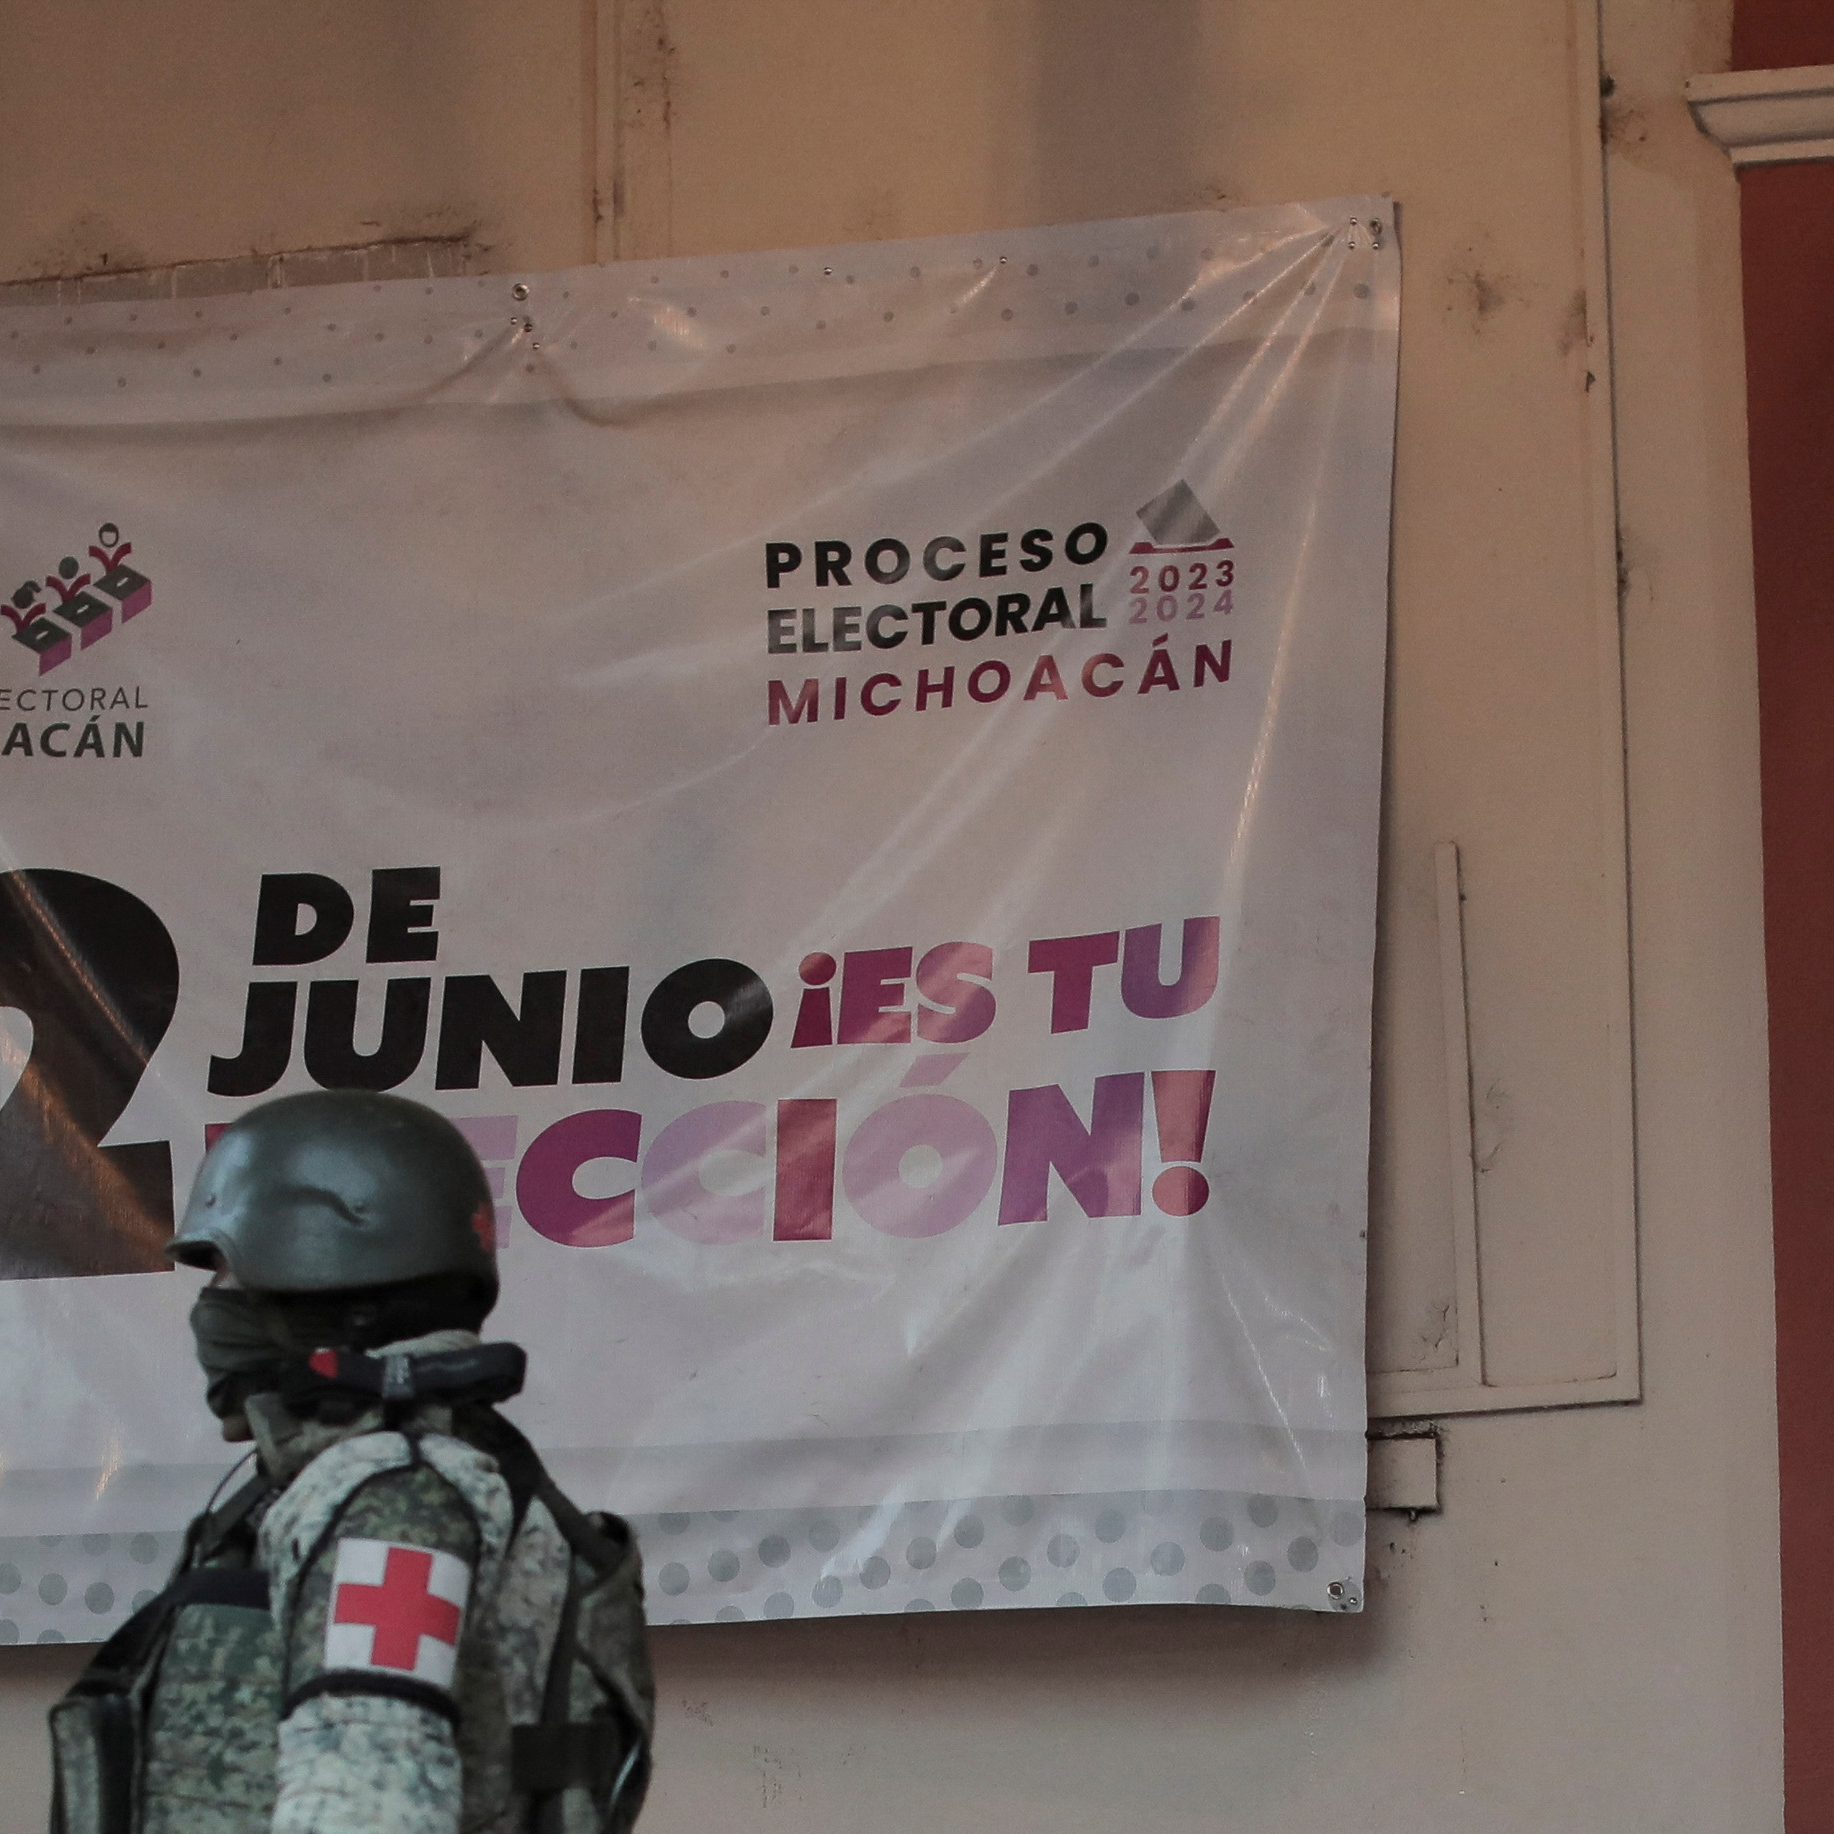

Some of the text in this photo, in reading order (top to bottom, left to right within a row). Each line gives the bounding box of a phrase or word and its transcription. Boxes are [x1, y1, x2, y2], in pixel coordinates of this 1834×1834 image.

[765, 521, 1108, 588] PROCESO
[1129, 560, 1235, 594] 2023
[767, 582, 1107, 655] ELECTORAL
[1128, 589, 1235, 626] 2024
[767, 633, 1232, 726] MICHOACÁN
[252, 865, 442, 966] DE
[206, 958, 775, 1097] JUNIO
[1027, 916, 1221, 1035] TU
